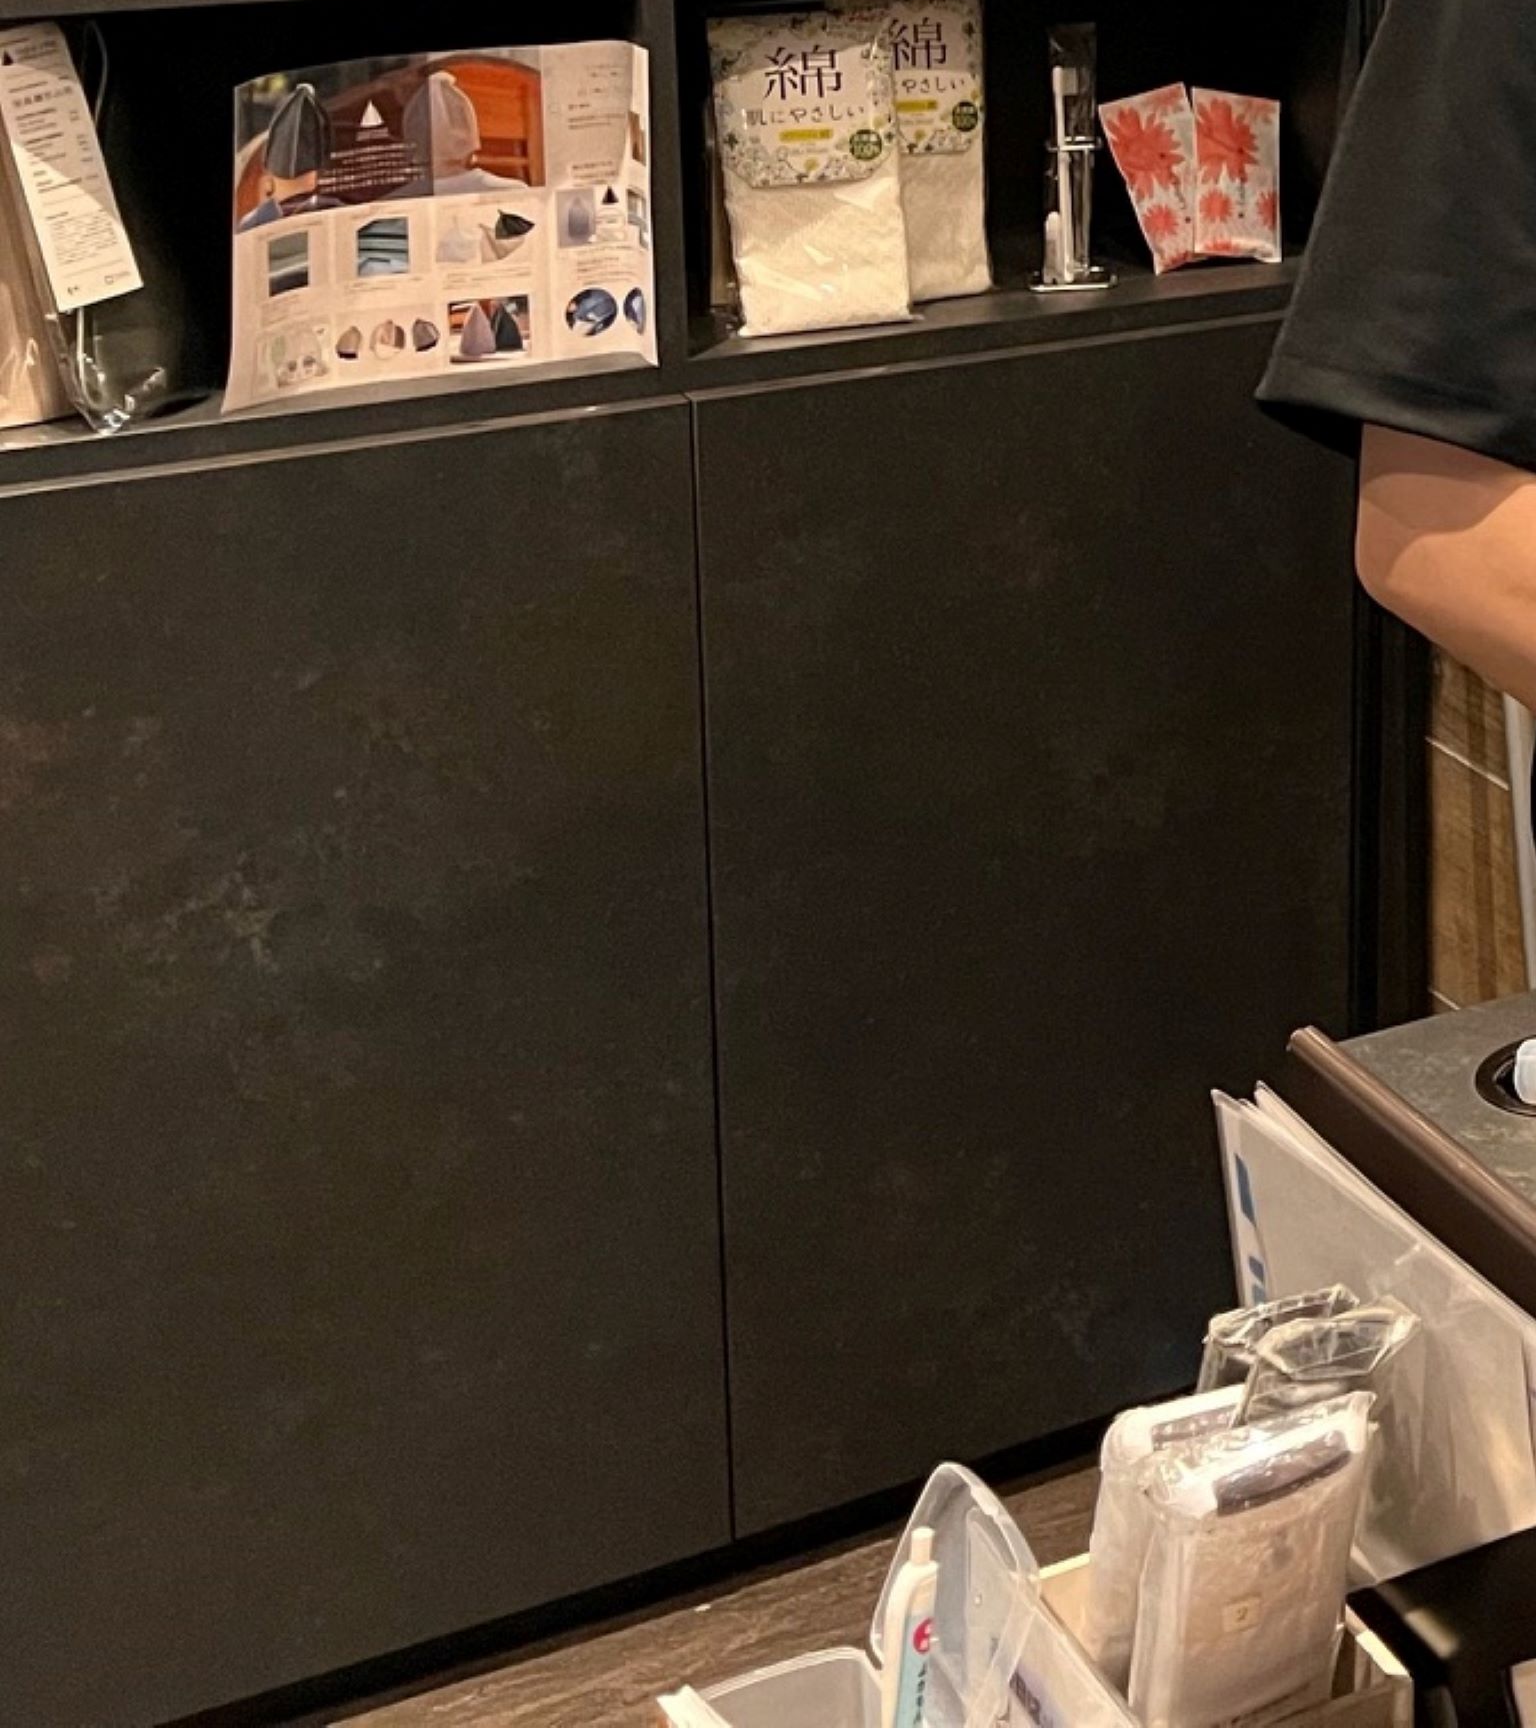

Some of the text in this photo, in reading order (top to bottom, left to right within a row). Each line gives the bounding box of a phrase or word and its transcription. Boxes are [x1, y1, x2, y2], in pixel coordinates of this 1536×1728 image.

[886, 16, 947, 71] 綿
[763, 44, 843, 100] 綿
[746, 103, 866, 127] 肌にやさしい
